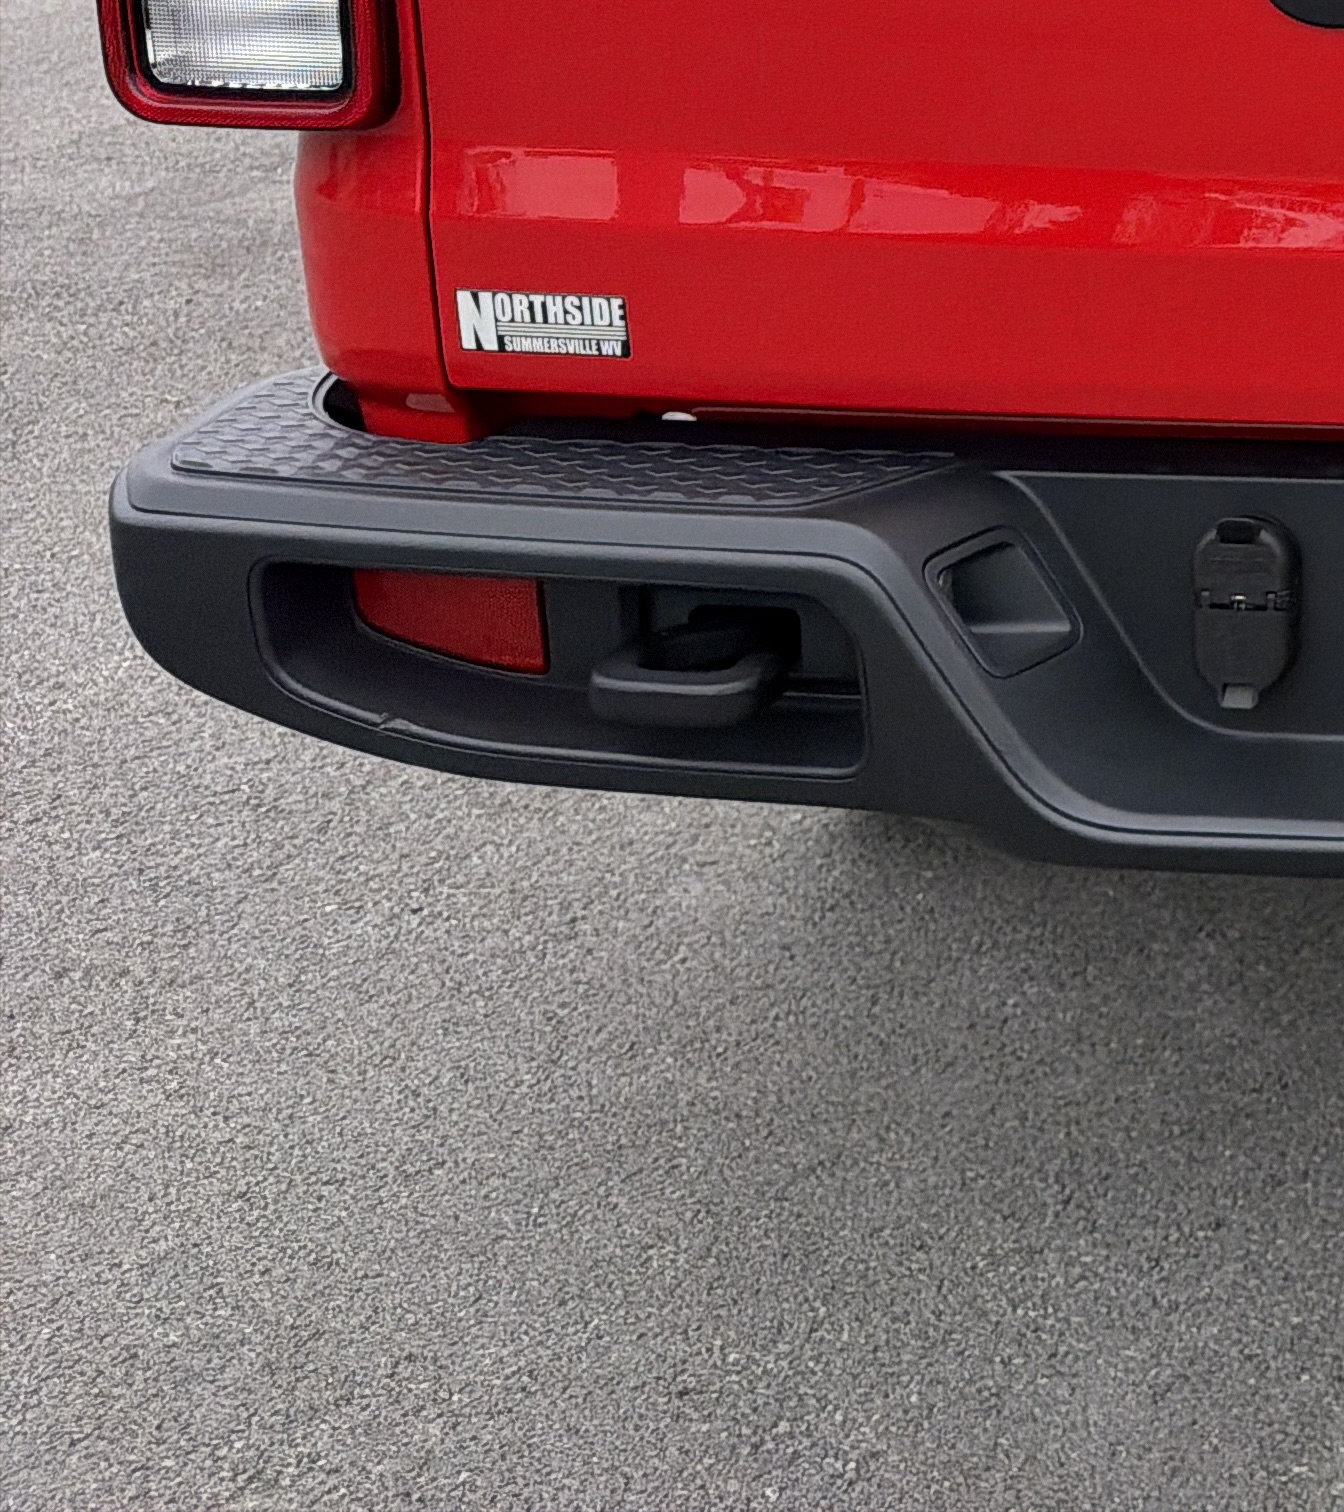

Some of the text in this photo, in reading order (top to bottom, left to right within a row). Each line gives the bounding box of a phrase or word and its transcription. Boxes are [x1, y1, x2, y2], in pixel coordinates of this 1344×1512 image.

[456, 290, 626, 352] NORTHSIDE
[503, 335, 622, 356] SUMMERSVILLE WV
